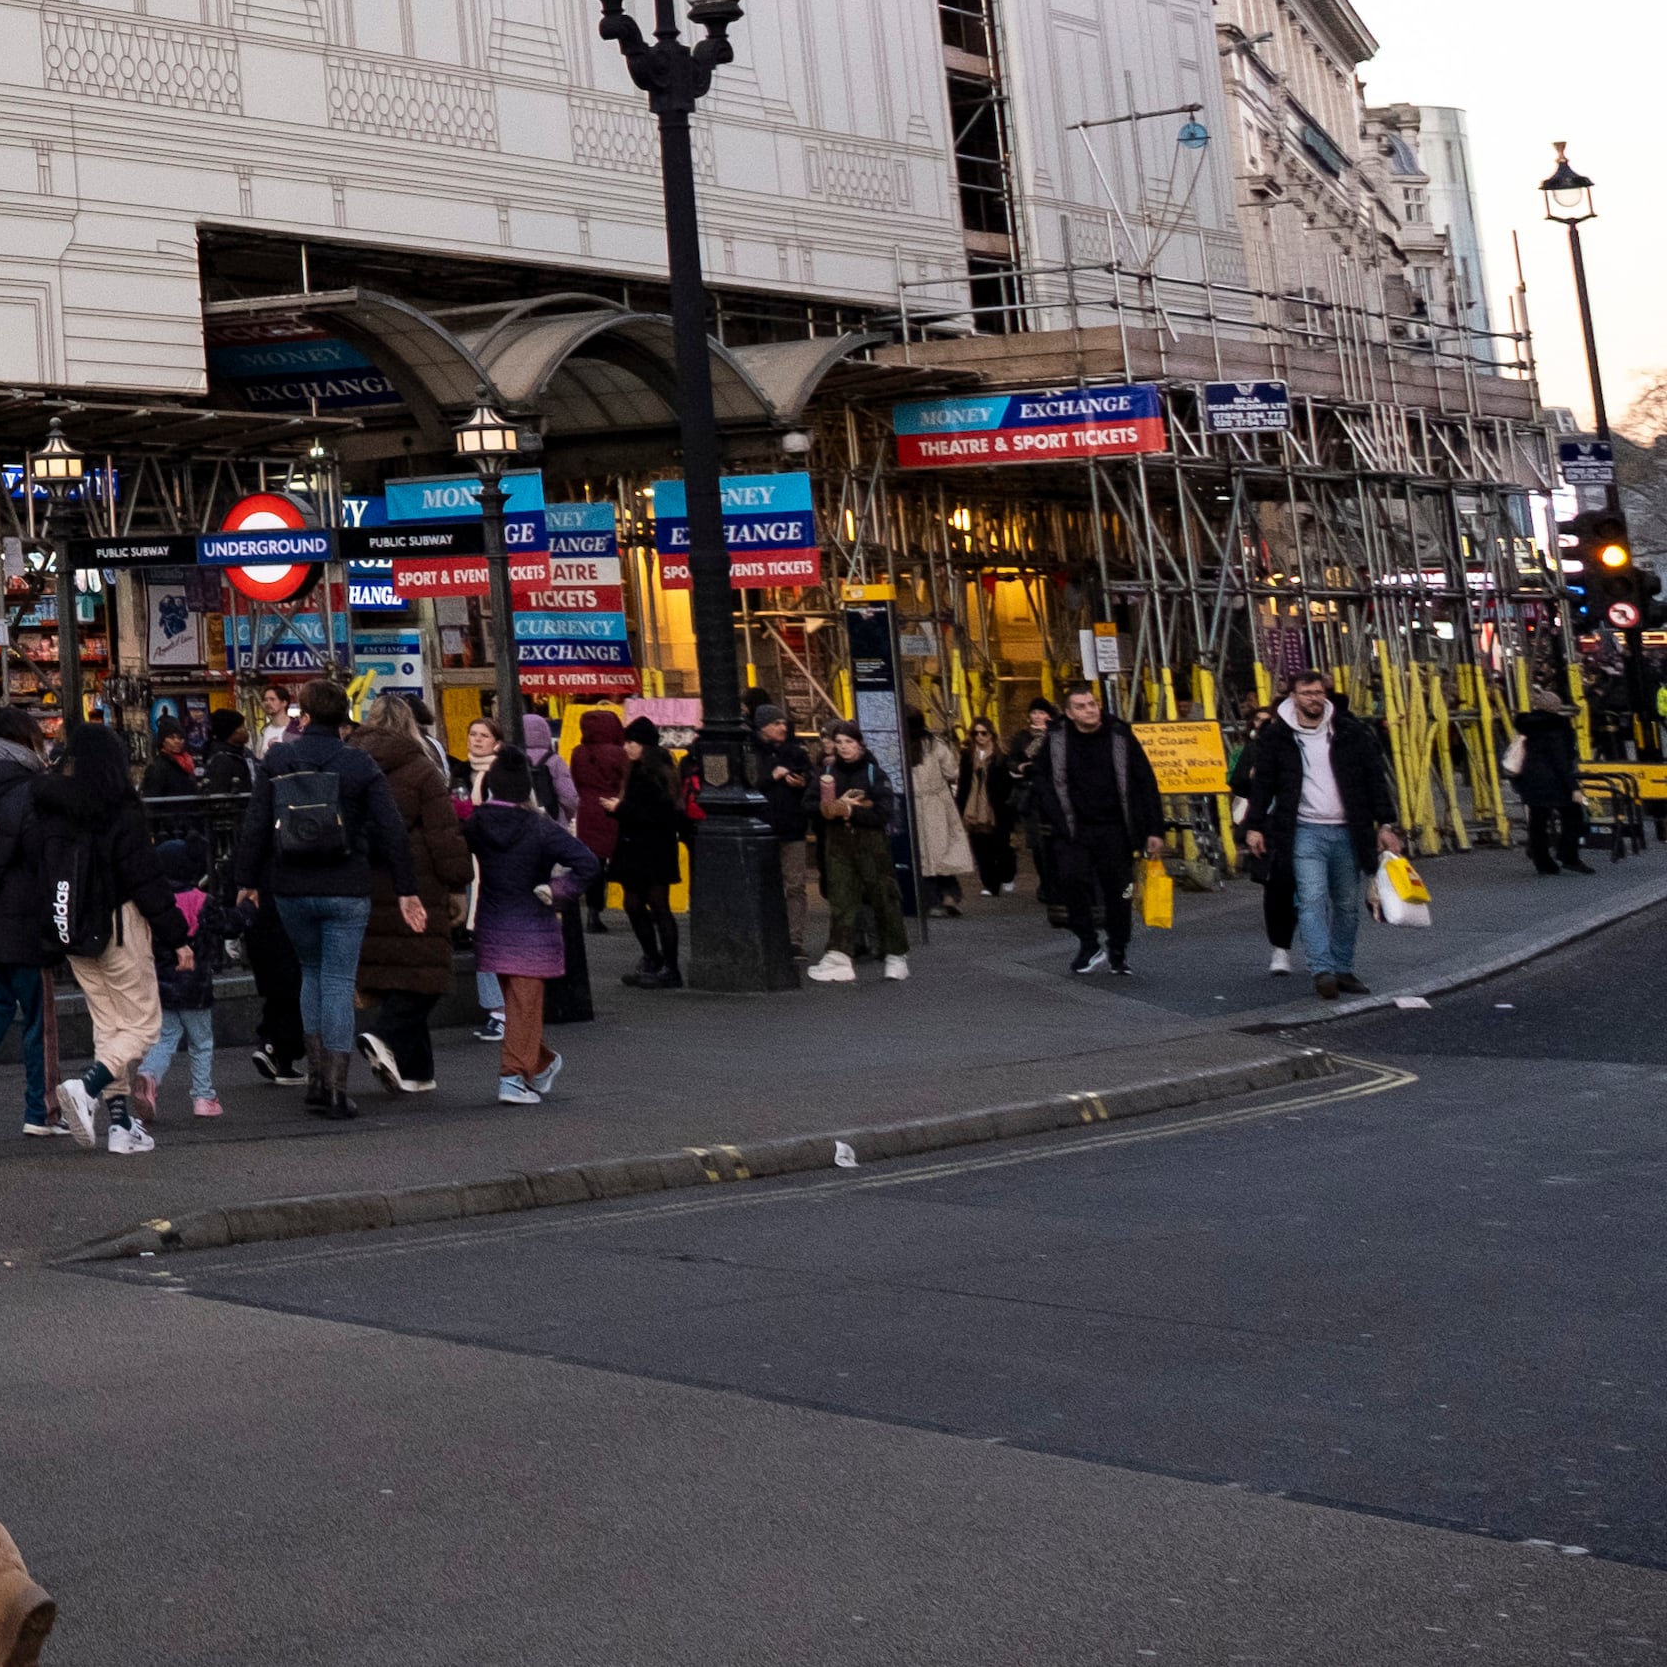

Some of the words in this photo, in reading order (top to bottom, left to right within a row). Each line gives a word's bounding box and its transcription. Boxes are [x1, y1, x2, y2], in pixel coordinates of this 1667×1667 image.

[919, 406, 994, 427] MONEY
[1019, 396, 1132, 420] EXCHANGE
[918, 435, 990, 457] THEATRE
[994, 436, 1009, 452] &
[1014, 432, 1068, 451] SPORT
[1072, 426, 1139, 446] TICKETS
[720, 486, 776, 507] NEY
[546, 511, 587, 527] NEY
[204, 538, 327, 557] UNDERGROUND
[369, 536, 407, 548] PUBLIC
[409, 534, 453, 546] SUBWAY
[96, 547, 129, 559] PUBLIC
[131, 545, 169, 557] SUBWAY
[398, 570, 436, 586] SPORT
[441, 570, 450, 584] &
[454, 568, 490, 584] EVENT
[508, 564, 546, 580] ICKETS
[554, 563, 598, 580] ATRE
[729, 562, 765, 577] VENTS
[768, 560, 814, 575] TICKETS
[528, 590, 597, 607] TICKETS
[516, 619, 615, 636] CURRENCY
[518, 644, 621, 661] EXCHANGE
[519, 673, 545, 686] PORT
[1158, 736, 1198, 745] Closed
[53, 881, 70, 943] adidas
